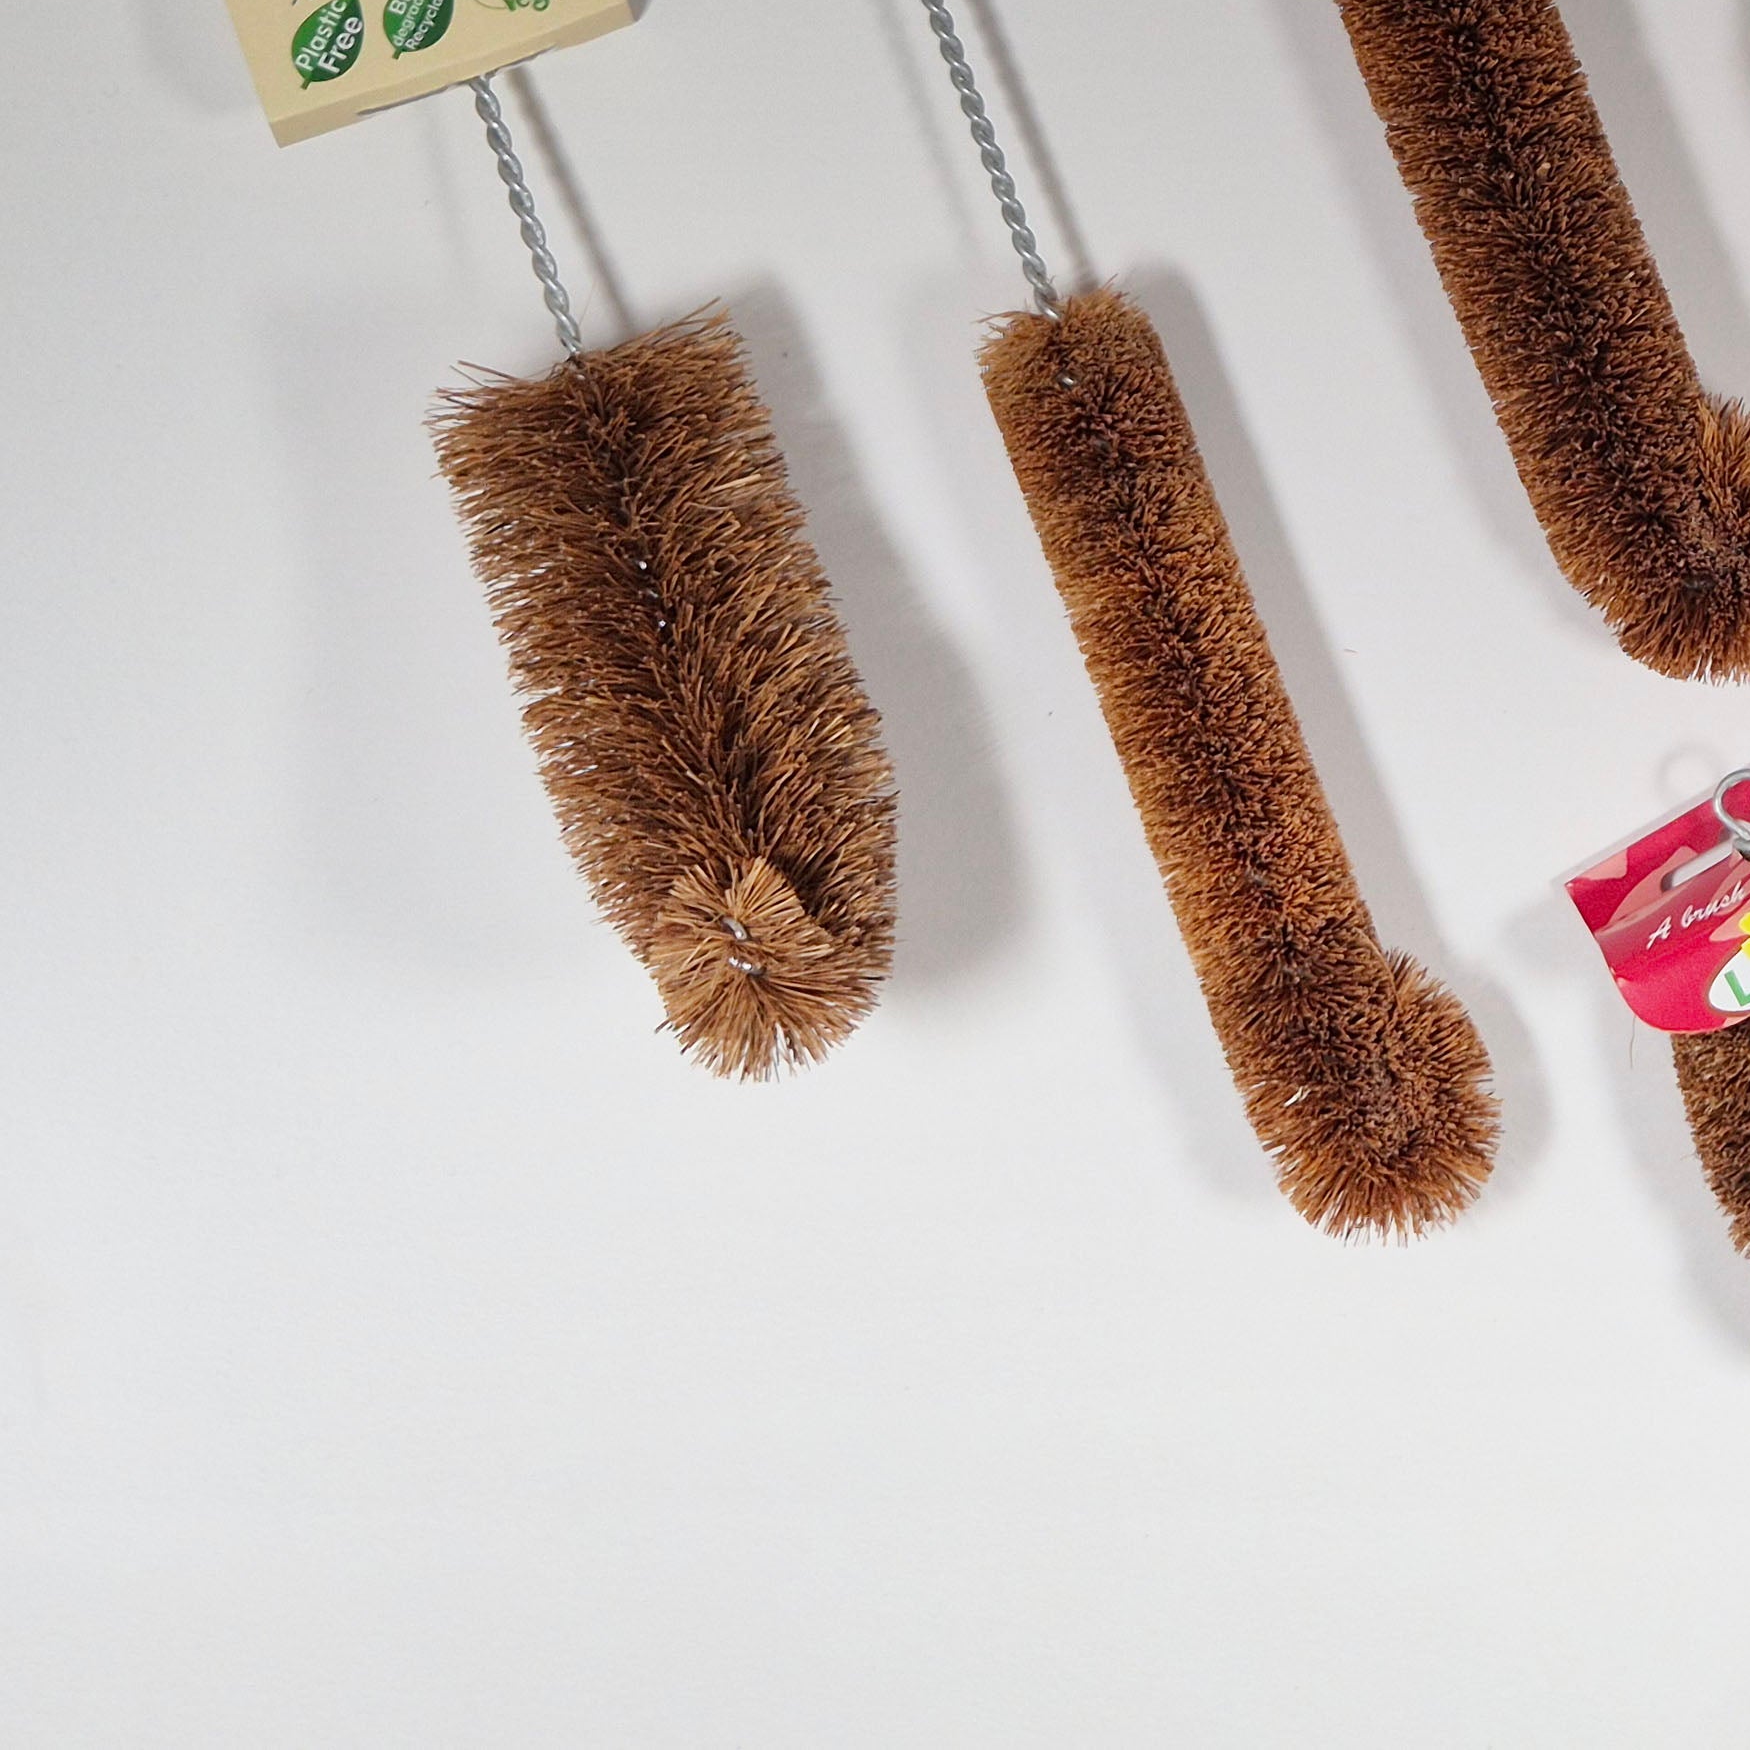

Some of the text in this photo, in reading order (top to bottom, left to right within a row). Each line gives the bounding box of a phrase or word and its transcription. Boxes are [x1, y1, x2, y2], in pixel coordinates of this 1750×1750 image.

[317, 16, 366, 73] Free
[1645, 915, 1672, 950] A
[1680, 880, 1746, 928] brush
